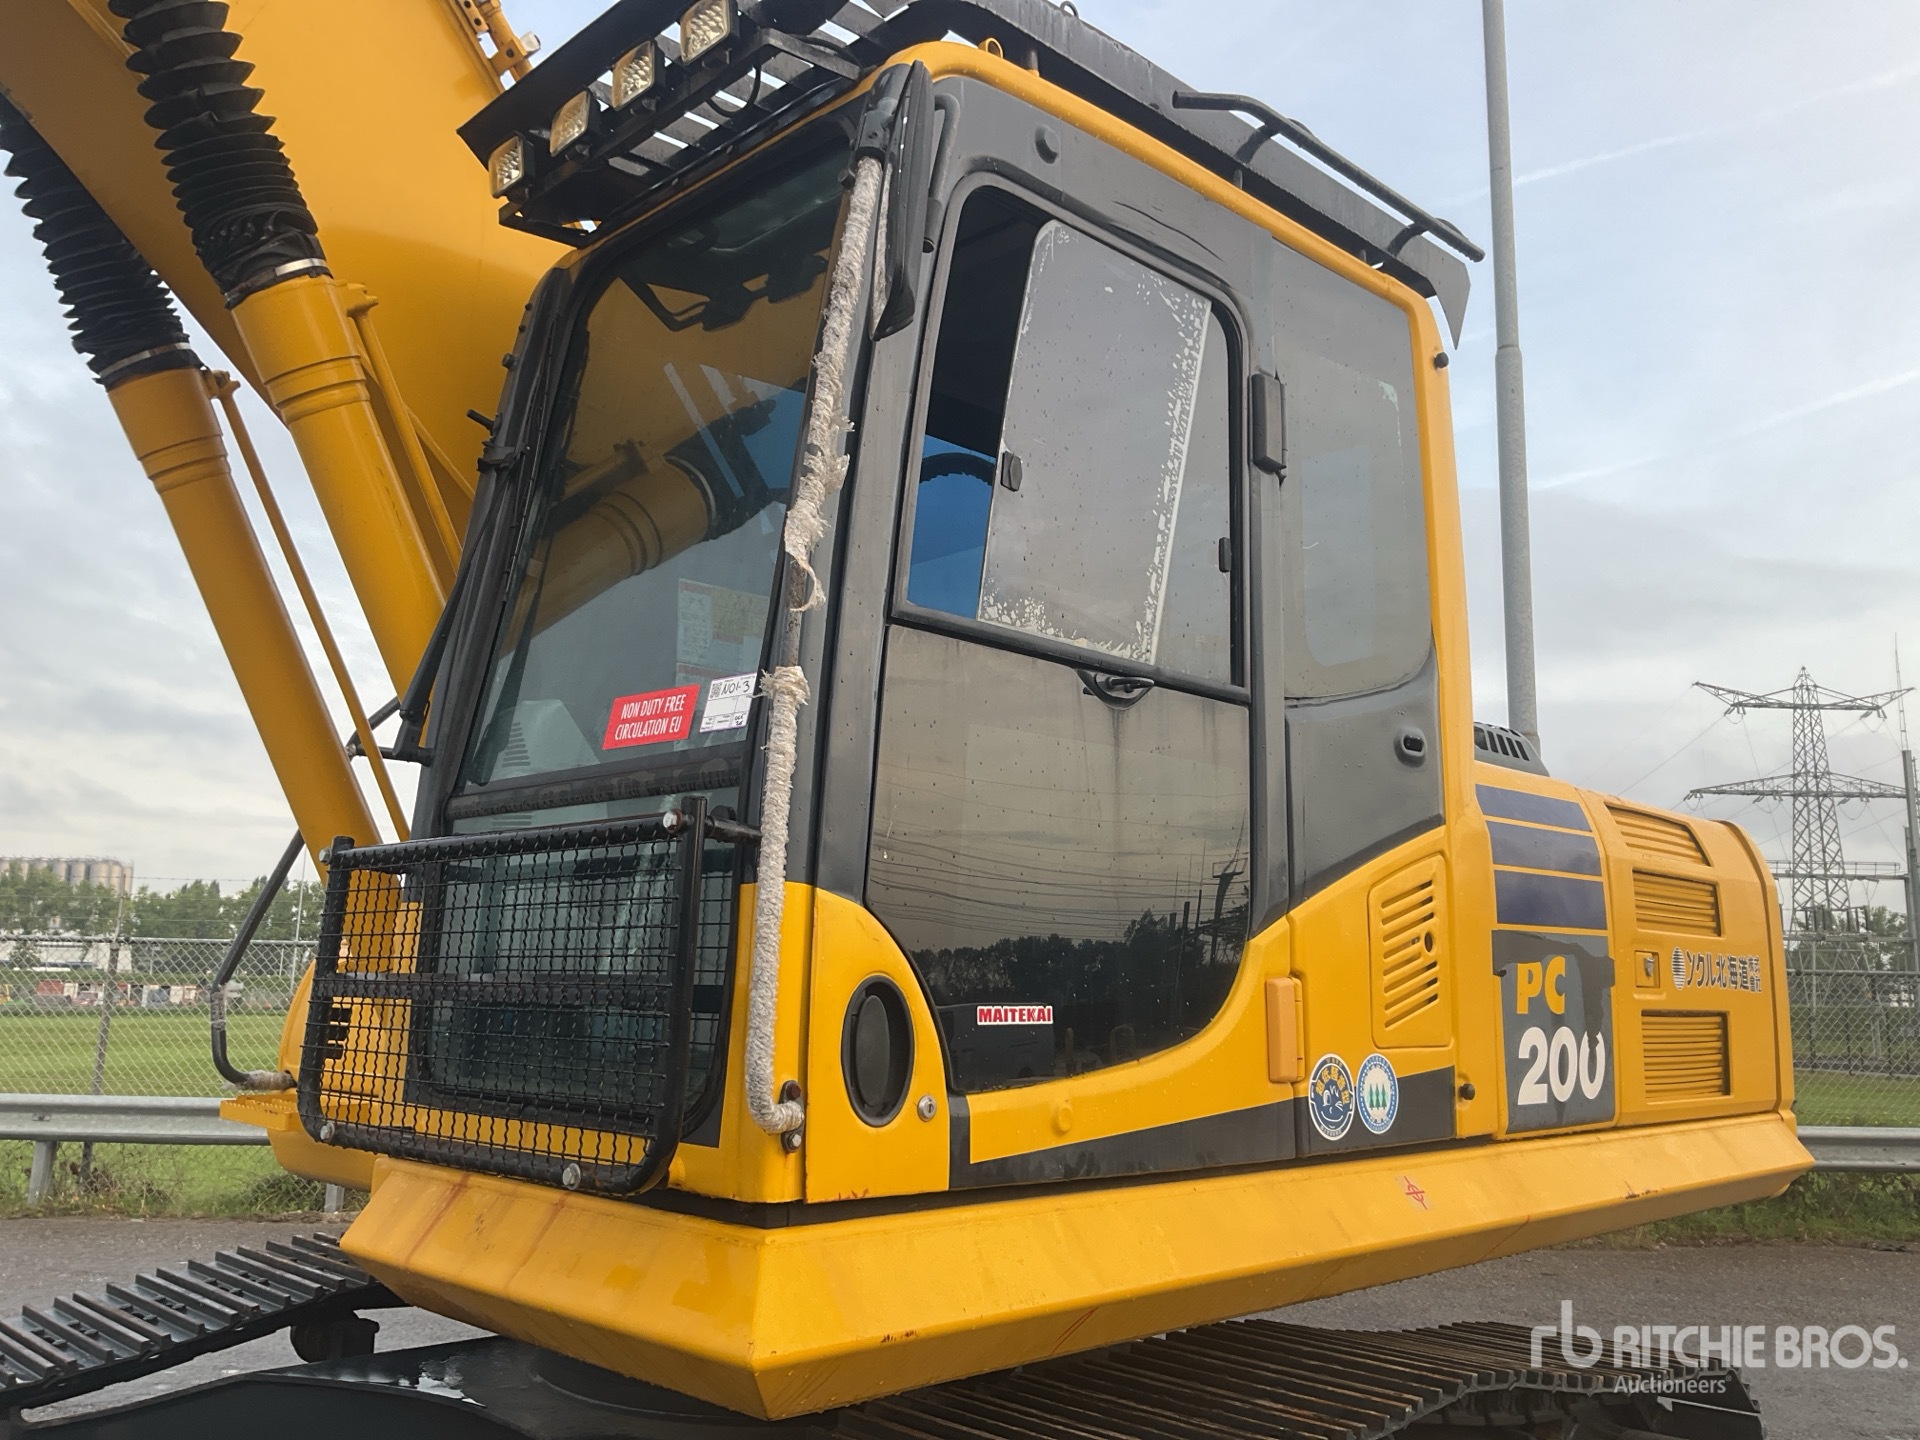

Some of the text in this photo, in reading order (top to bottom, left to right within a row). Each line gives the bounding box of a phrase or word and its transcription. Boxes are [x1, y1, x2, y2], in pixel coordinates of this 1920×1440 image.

[620, 694, 687, 720] NON DUTY FREE
[614, 717, 669, 741] CIRCULATION
[669, 715, 683, 733] EU
[1516, 955, 1566, 1015] PC
[978, 1007, 1052, 1023] MAITEKAI
[1517, 1026, 1606, 1106] 200
